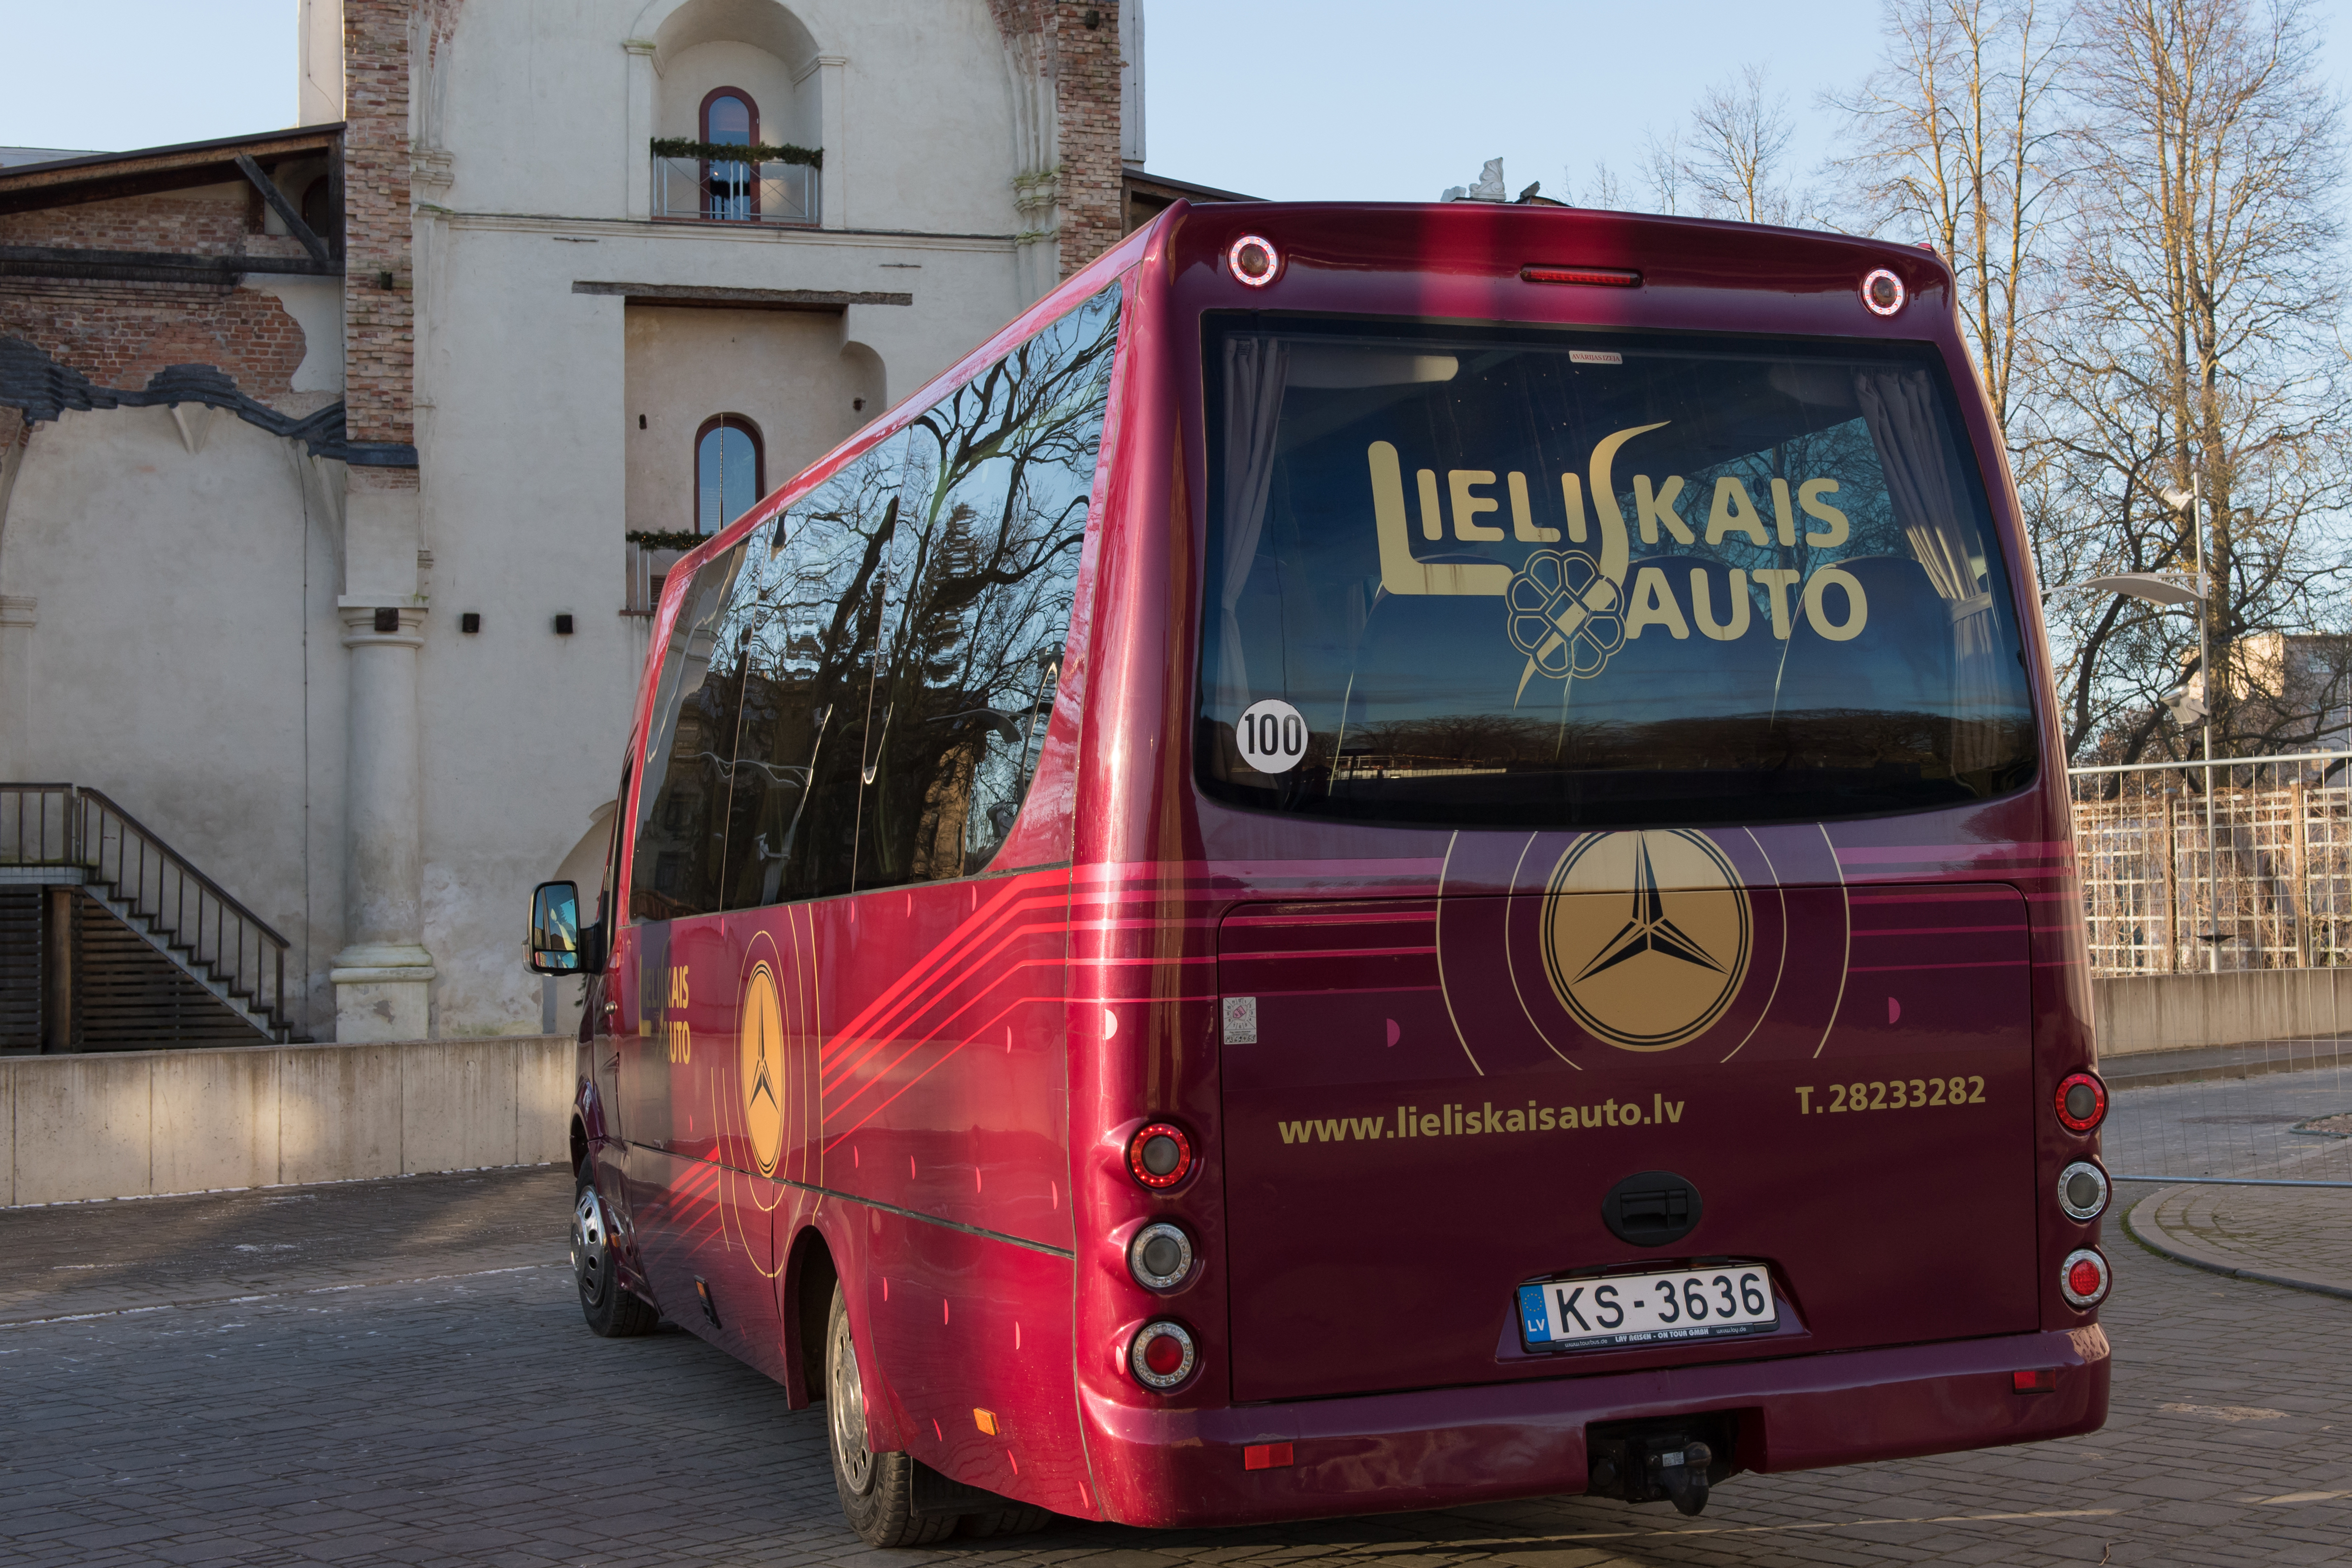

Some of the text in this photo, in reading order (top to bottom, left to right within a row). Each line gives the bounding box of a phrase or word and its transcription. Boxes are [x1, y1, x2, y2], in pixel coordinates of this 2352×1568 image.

[1367, 420, 1850, 596] LIELISKAIS
[1625, 567, 1868, 641] AUTO
[1245, 713, 1302, 756] 100
[663, 1021, 691, 1065] AUTO
[1795, 1075, 1986, 1115] T.28233282
[1278, 1093, 1685, 1144] www.lieliskaisauto.lv
[1556, 1273, 1765, 1334] KS-3636
[1527, 1319, 1545, 1333] LV
[1564, 1338, 1608, 1348] www.tourbus.de
[1629, 1333, 1652, 1341] REISEN
